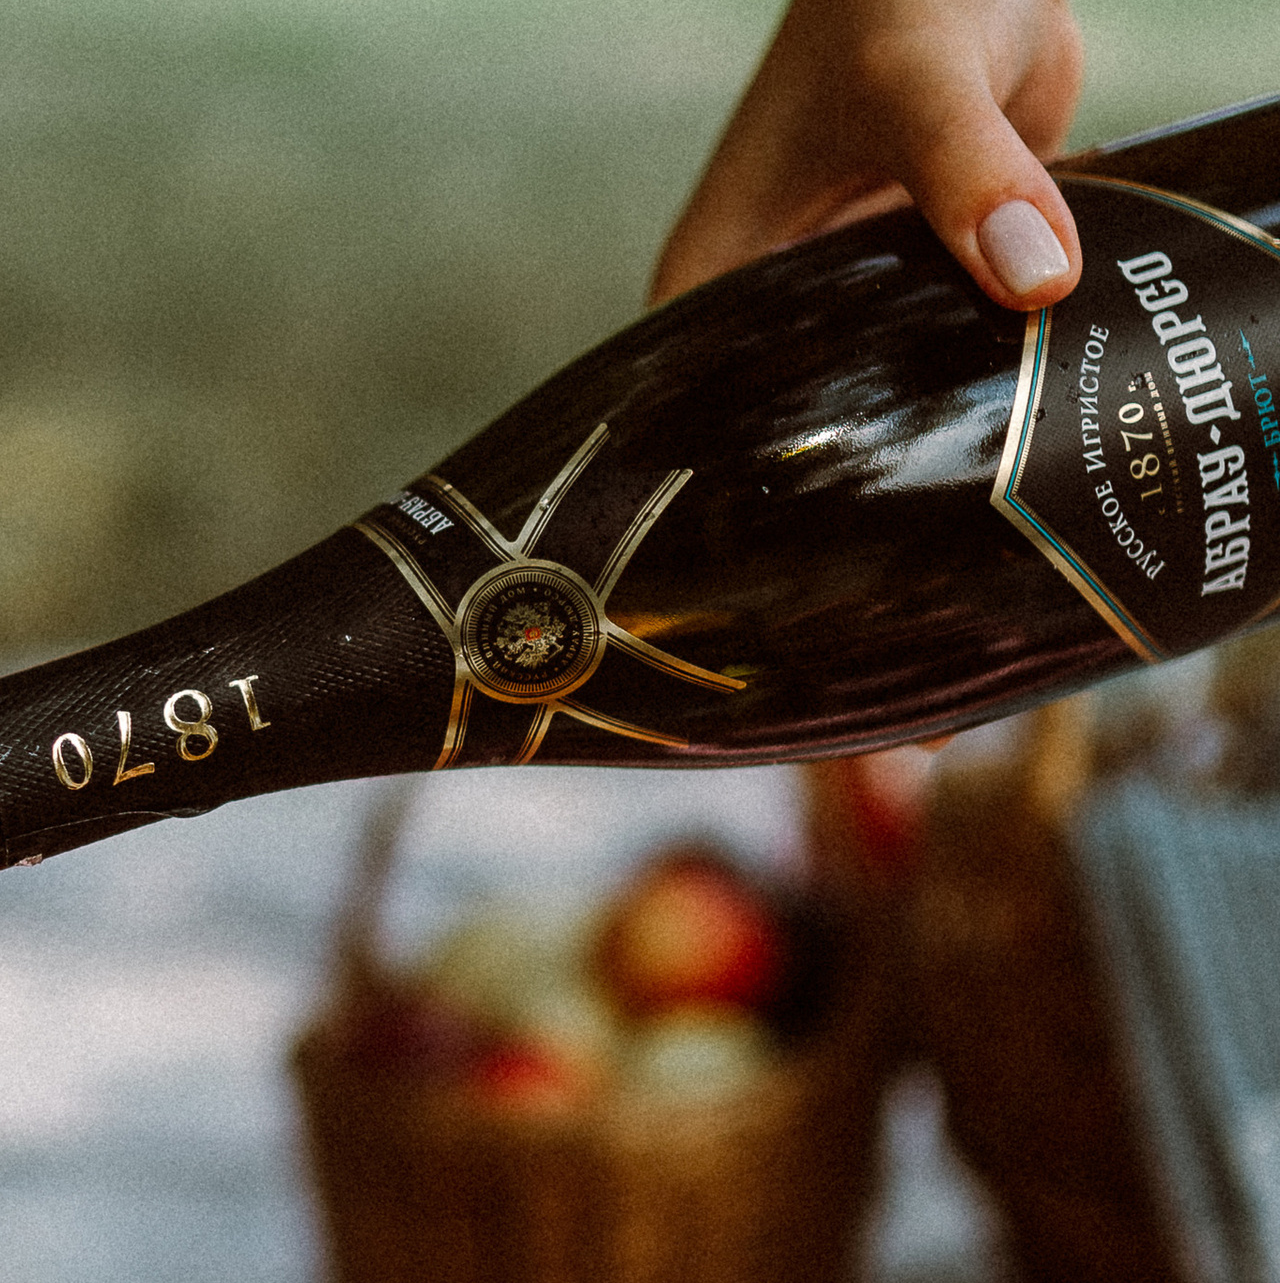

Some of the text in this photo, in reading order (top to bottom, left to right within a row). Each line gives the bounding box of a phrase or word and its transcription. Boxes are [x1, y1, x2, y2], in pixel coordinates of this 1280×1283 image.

[1079, 323, 1166, 581] РУССКОЕ ИГРИСТОЕ
[1118, 402, 1163, 501] 1870
[1248, 373, 1280, 449] БРЮТ
[51, 674, 272, 791] 1870
